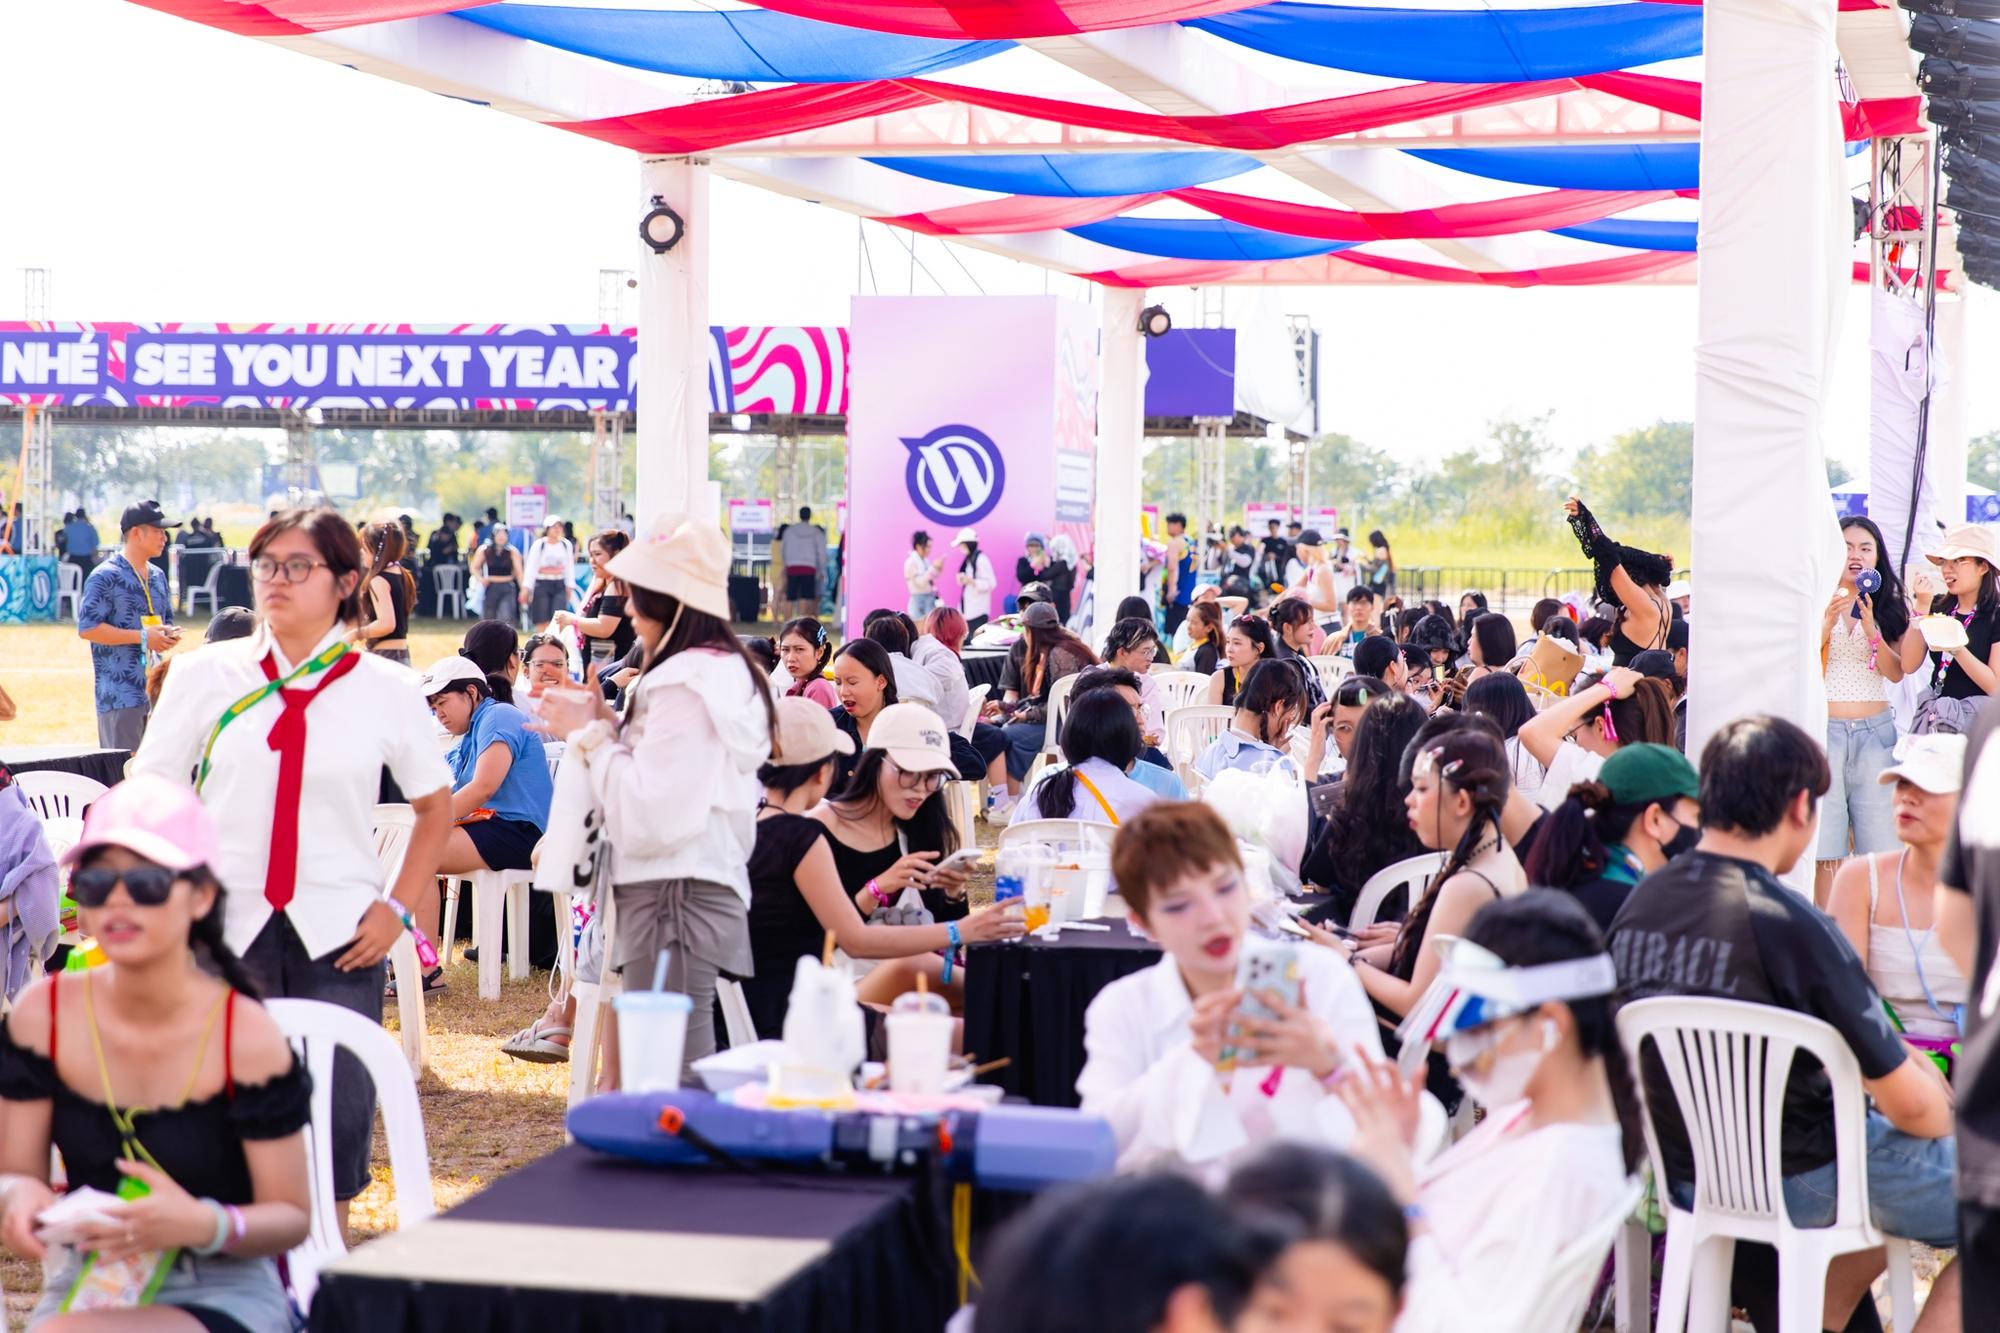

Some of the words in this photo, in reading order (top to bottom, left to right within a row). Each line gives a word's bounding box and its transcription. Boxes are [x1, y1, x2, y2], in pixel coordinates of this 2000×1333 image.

[2, 333, 99, 385] NHÉ
[133, 342, 216, 386] SEE
[222, 343, 328, 387] YOU
[336, 345, 472, 387] NEXT
[479, 346, 620, 388] YEAR
